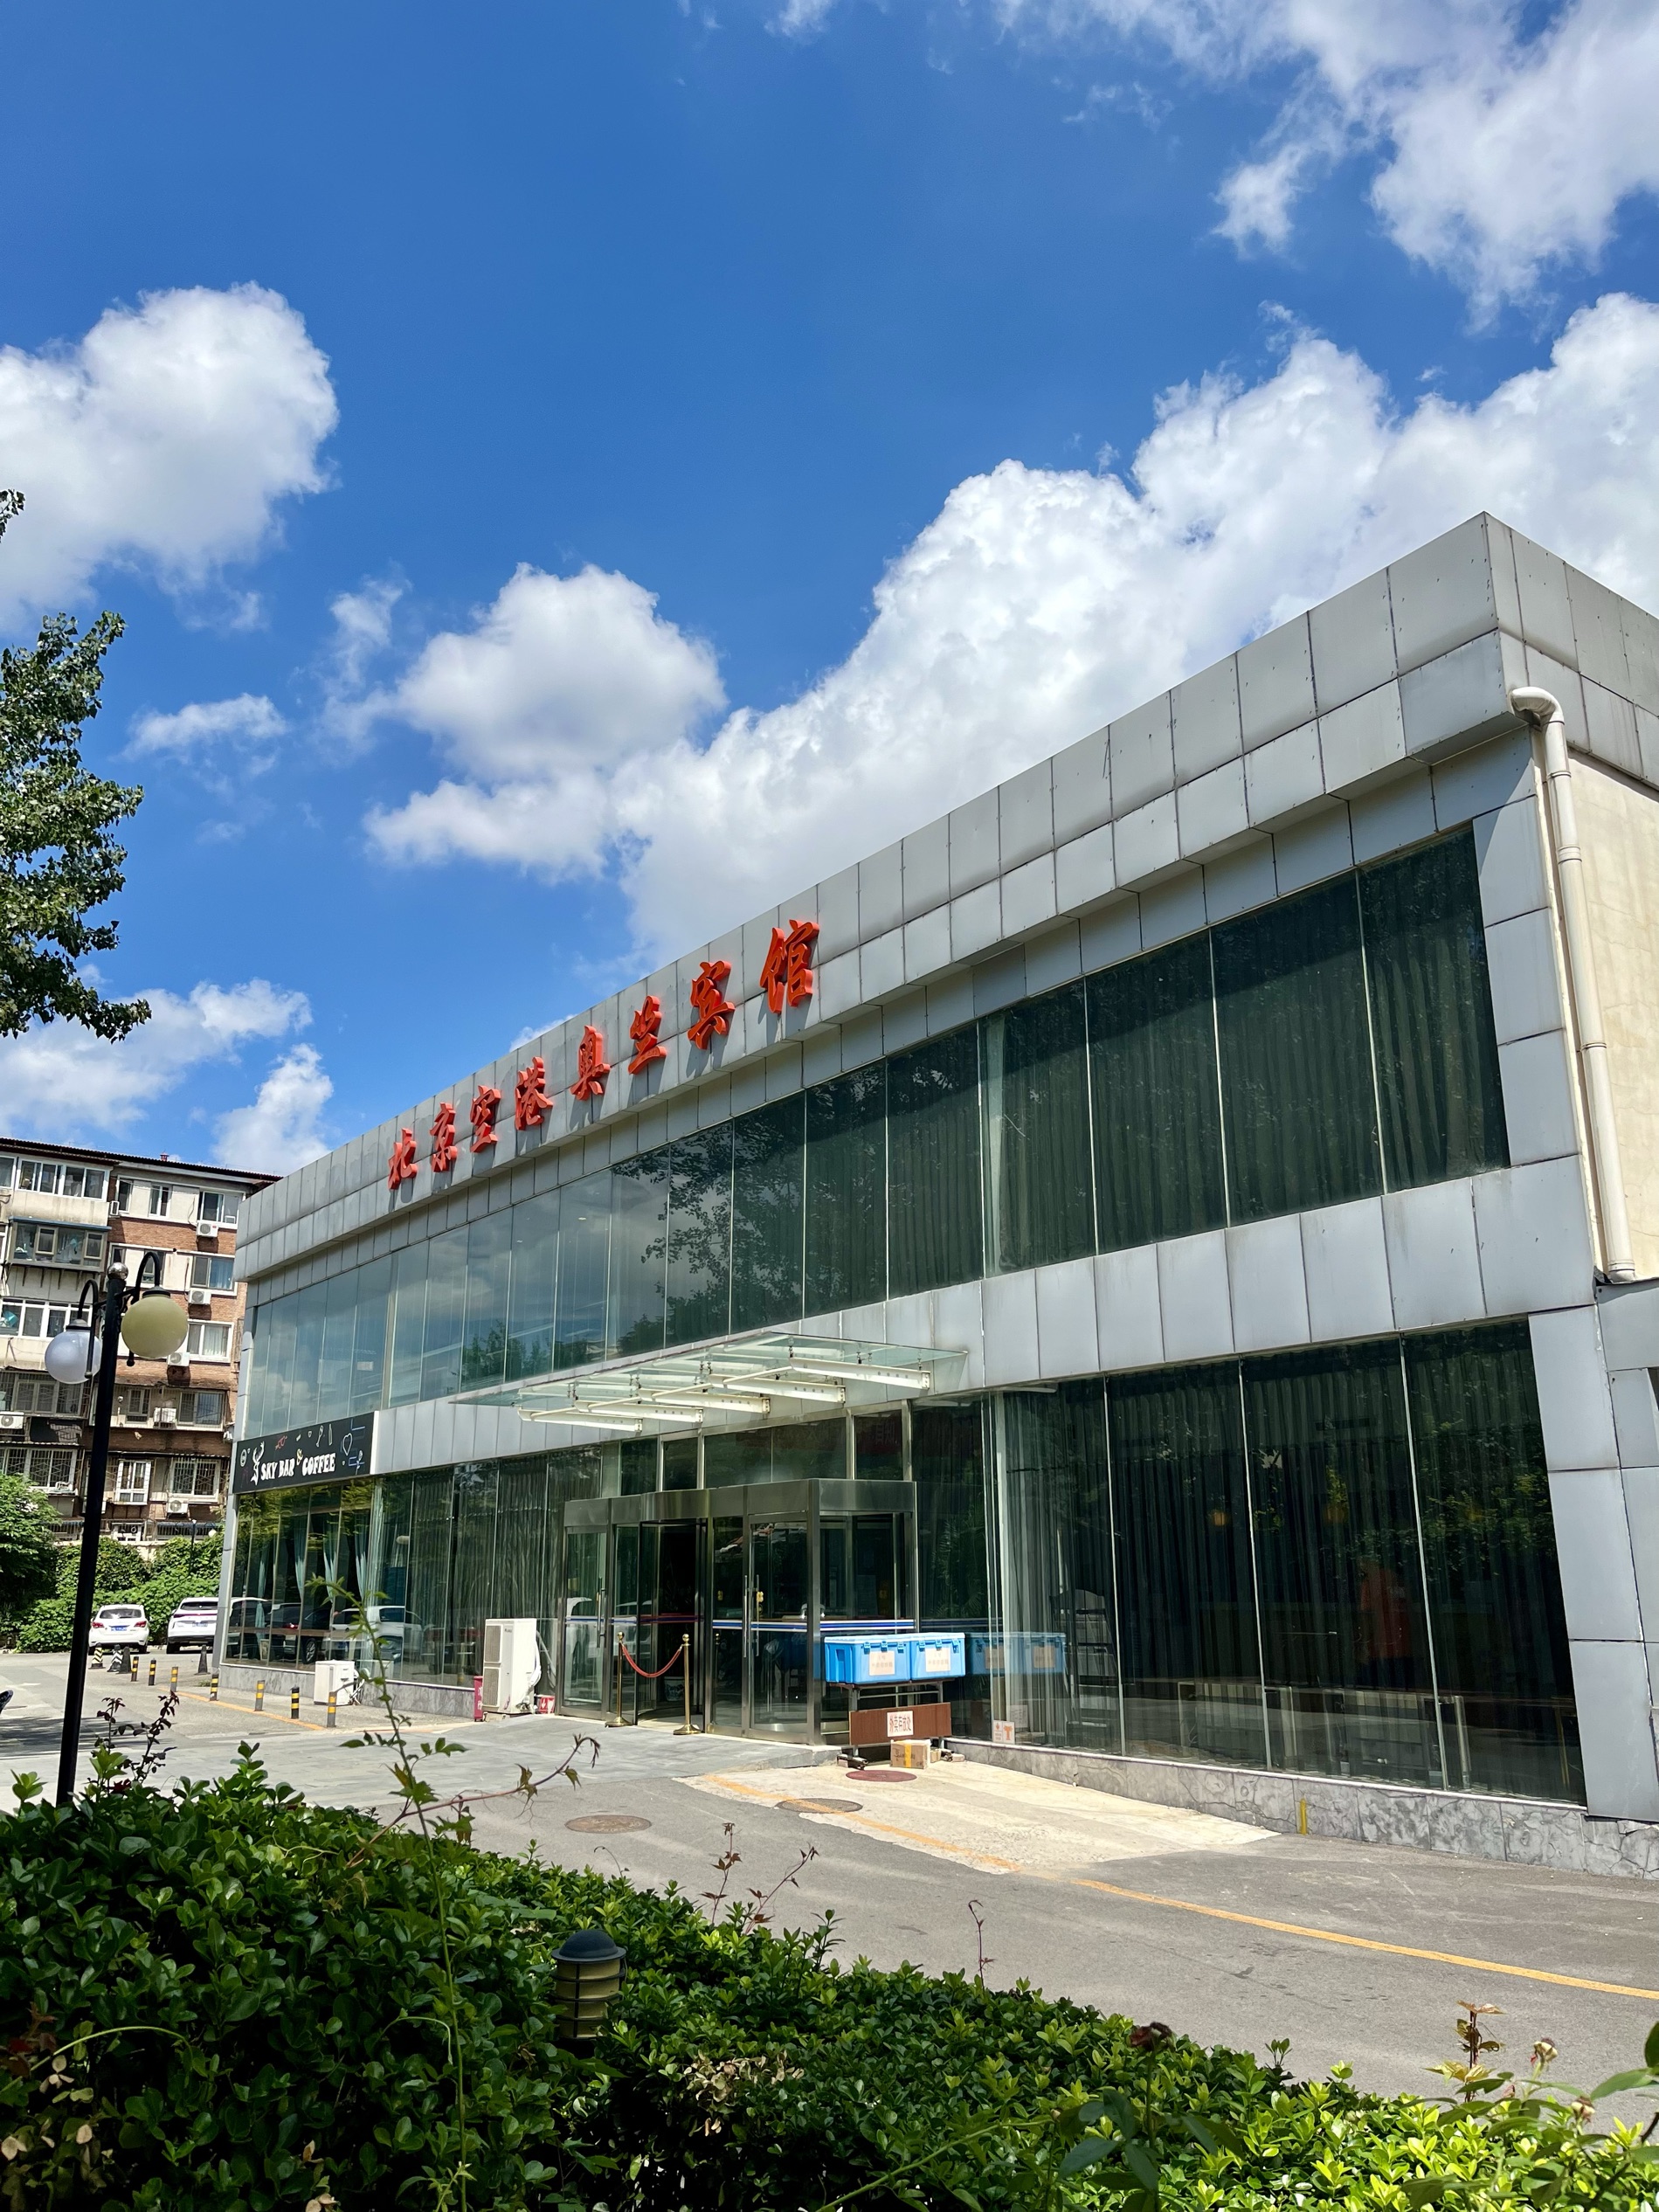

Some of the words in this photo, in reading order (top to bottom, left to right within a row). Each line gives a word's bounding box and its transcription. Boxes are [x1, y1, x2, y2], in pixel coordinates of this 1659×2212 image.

[261, 1462, 278, 1480] SKY
[278, 1458, 295, 1478] BAR
[301, 1453, 336, 1476] COFFEE
